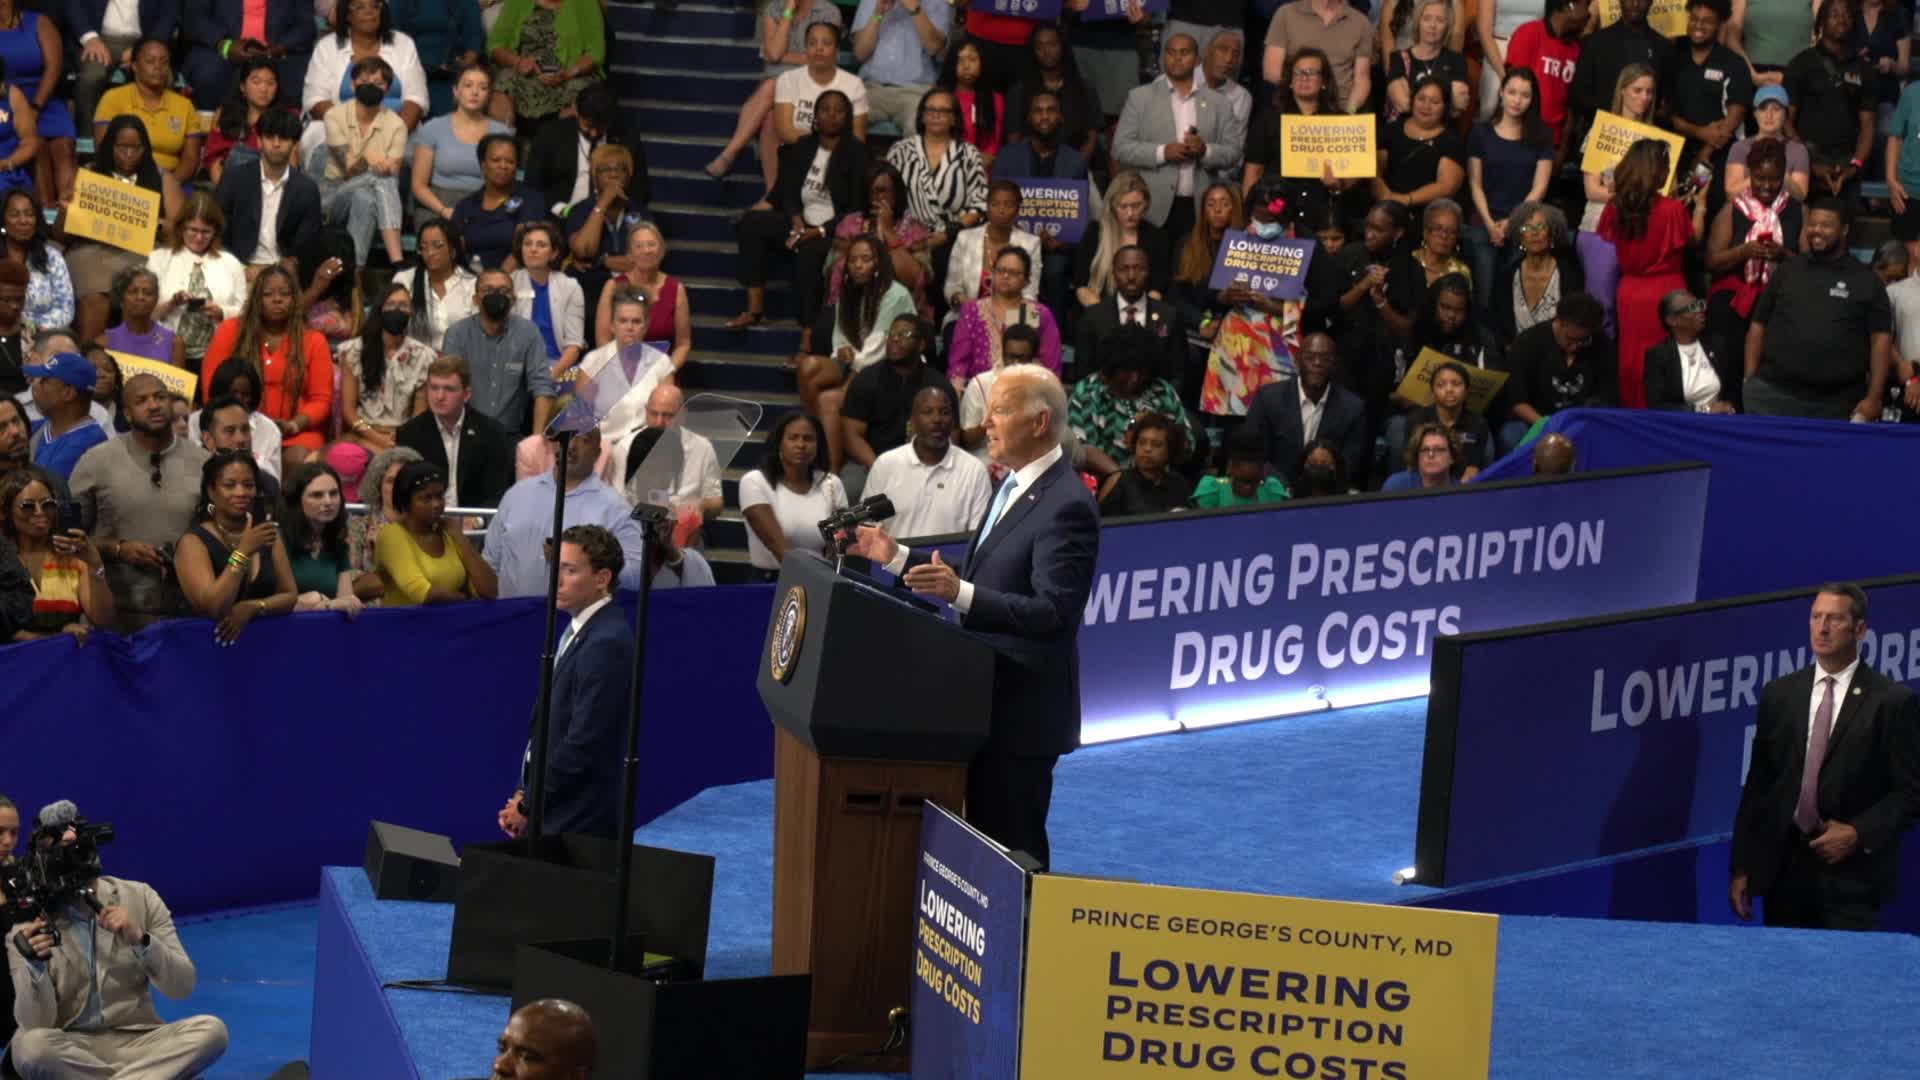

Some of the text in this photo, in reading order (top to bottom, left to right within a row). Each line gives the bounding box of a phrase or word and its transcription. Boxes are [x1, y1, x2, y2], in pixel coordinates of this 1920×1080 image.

[1290, 126, 1366, 136] LOWERING
[1290, 136, 1366, 144] PRESCRIPTION
[1290, 145, 1366, 153] DRUG COSTS
[80, 182, 151, 210] LOWERING
[80, 191, 149, 219] PRESCRIPTION
[1020, 187, 1079, 201] WERING
[79, 200, 147, 228] DRUG COSTS
[1039, 209, 1079, 218] COSTS
[1226, 249, 1302, 267] PRESCRIPTION
[1229, 239, 1304, 258] LOWERING
[1224, 258, 1299, 276] DRUG COSTS
[1083, 520, 1605, 626] WERING PRESCRIPTION
[1169, 605, 1461, 690] DRUG COSTS
[1591, 646, 1815, 732] LOWERIN
[920, 879, 986, 957] LOWERING
[1072, 908, 1453, 957] PRINCE GEORGE'S COUNTY, MD
[918, 916, 983, 988] PRESCRIPTION
[916, 948, 982, 1025] DRUG COSTS
[1108, 951, 1411, 1012] LOWERING
[1106, 995, 1403, 1046] PRESCRIPTION
[1102, 1031, 1407, 1080] DRUG COSTS
